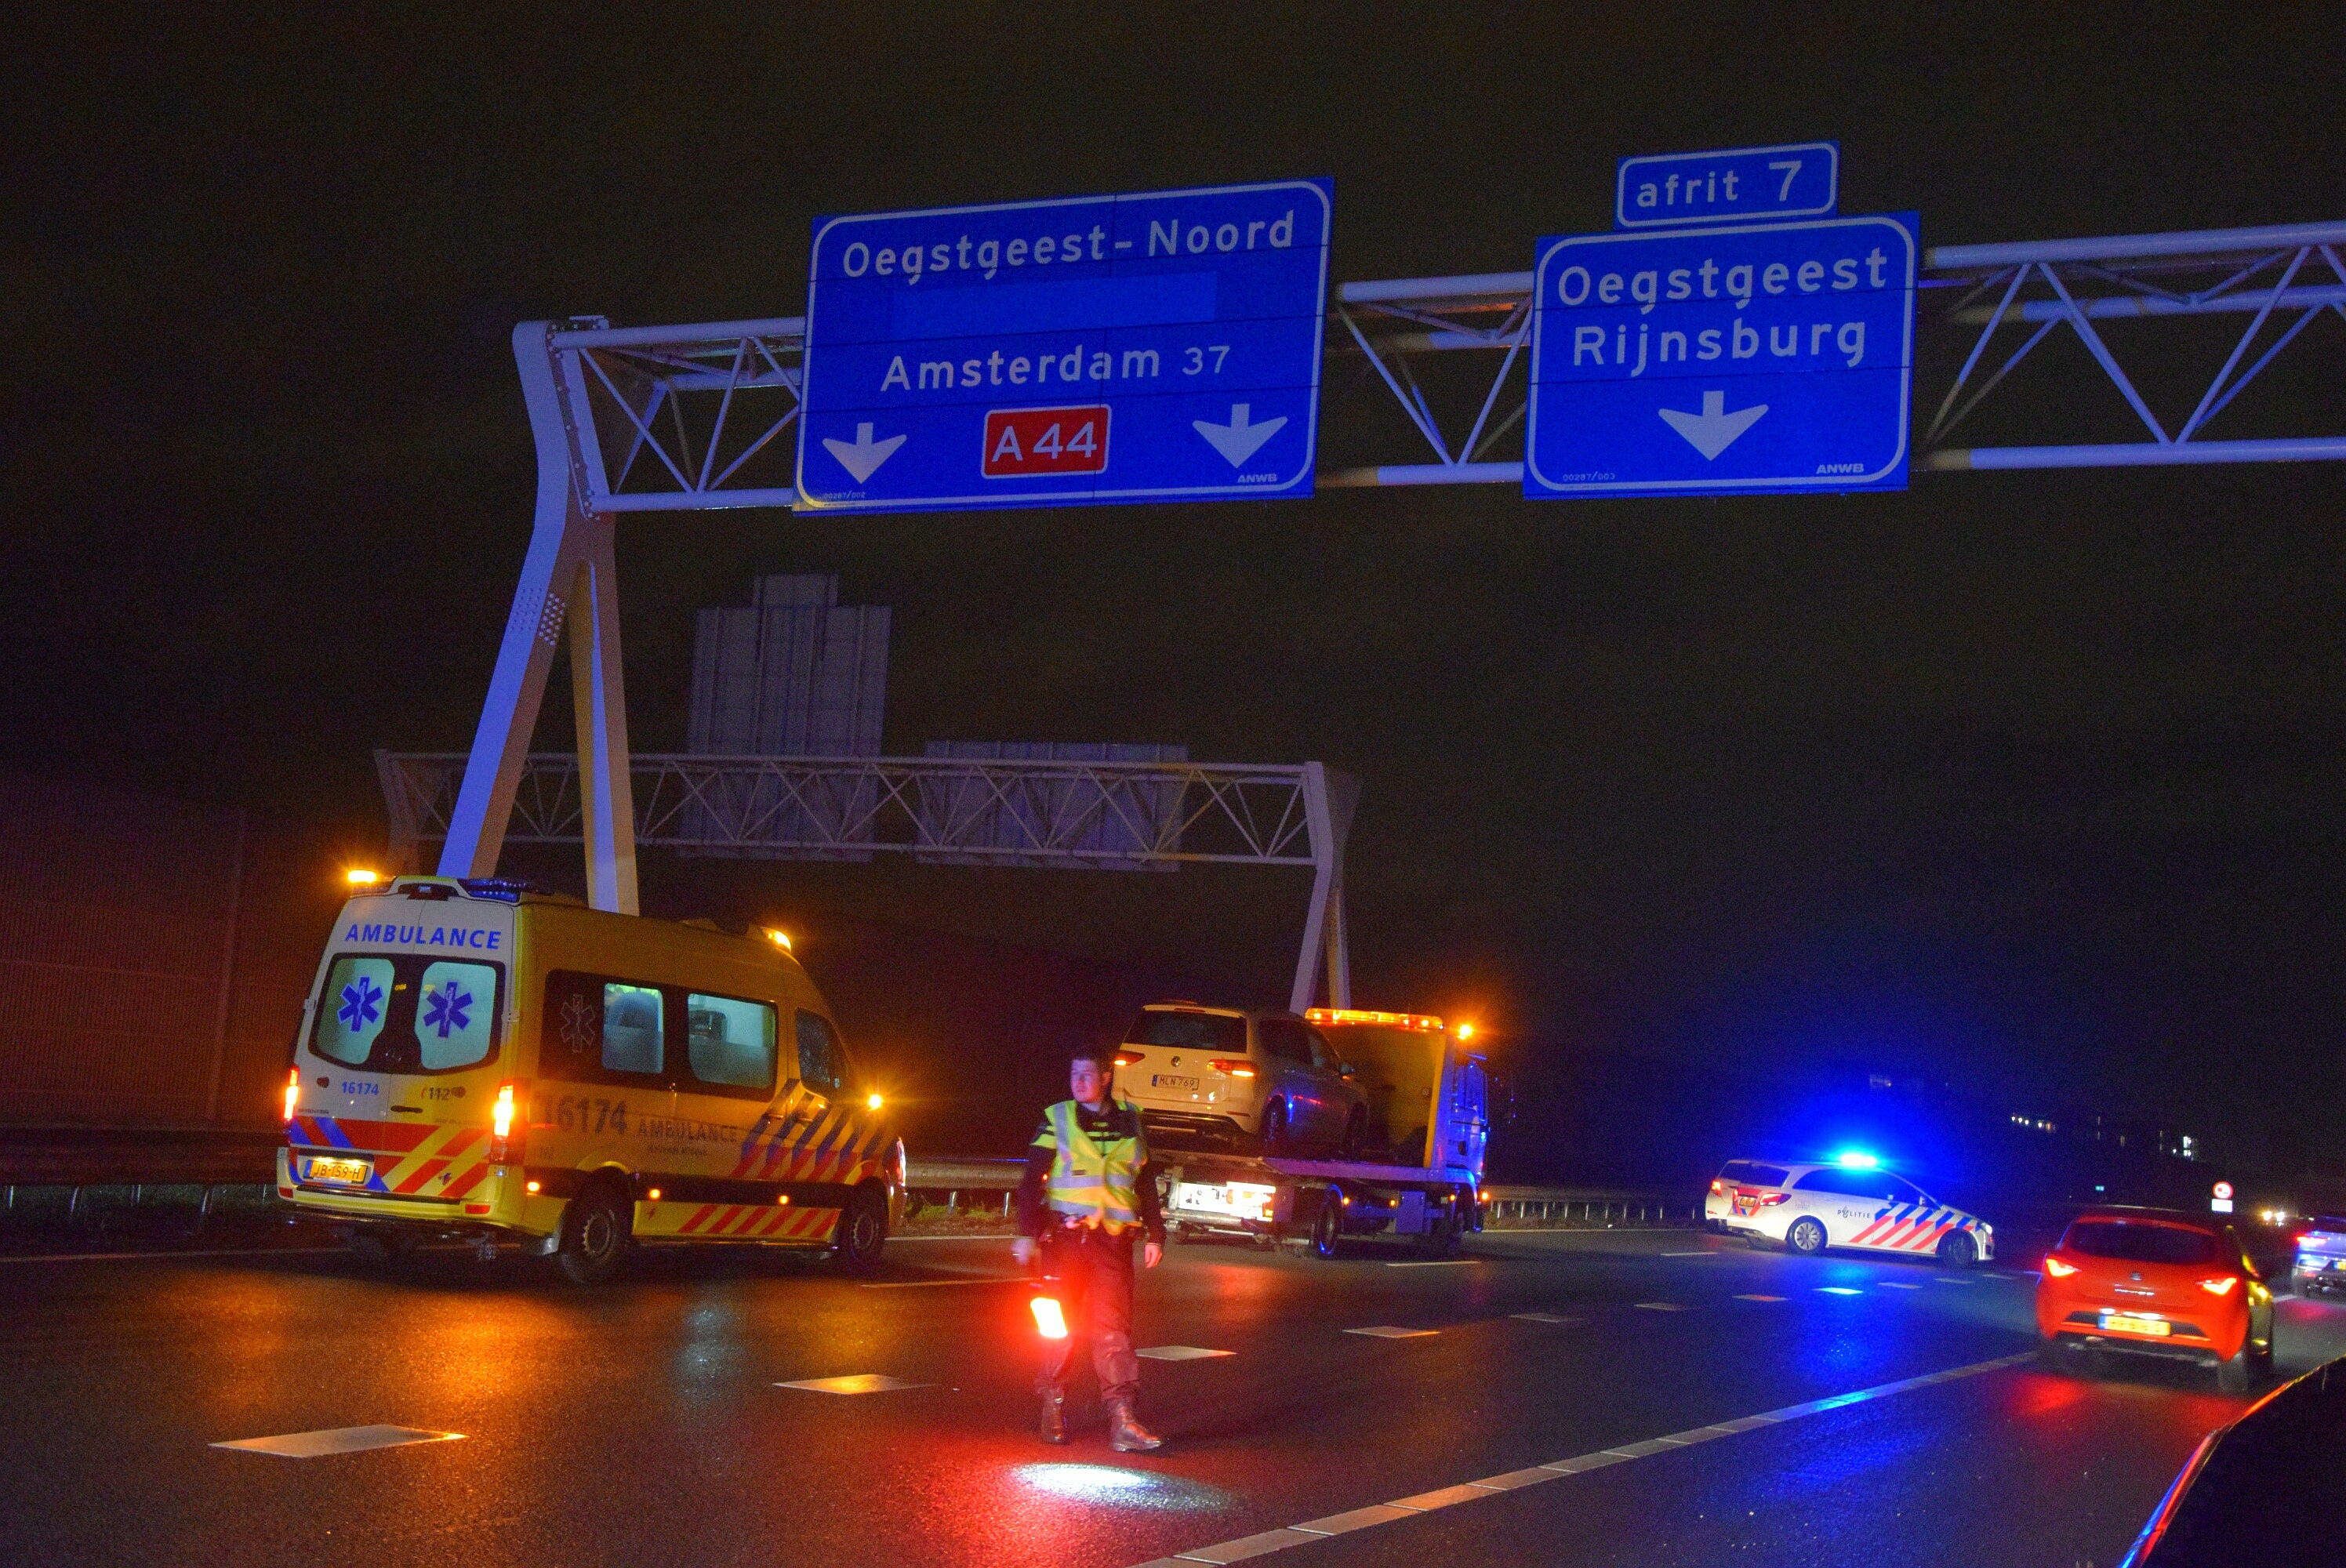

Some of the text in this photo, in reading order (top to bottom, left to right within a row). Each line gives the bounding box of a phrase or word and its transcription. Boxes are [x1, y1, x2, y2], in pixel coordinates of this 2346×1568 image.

[1637, 160, 1802, 207] afrit 7
[1558, 247, 1887, 315] Oegstgeest
[1574, 318, 1865, 378] Rijnsburg
[880, 345, 1231, 392] Amsterdam 37
[991, 421, 1098, 463] A 44
[1237, 474, 1277, 483] ANWB
[1816, 463, 1865, 474] ANWB
[345, 924, 502, 950] AMBULANCE
[341, 1081, 380, 1096] 16174
[1160, 1076, 1195, 1087] MLN 769
[637, 1118, 738, 1142] AMBULANCE
[1837, 1207, 1871, 1219] POLITIE
